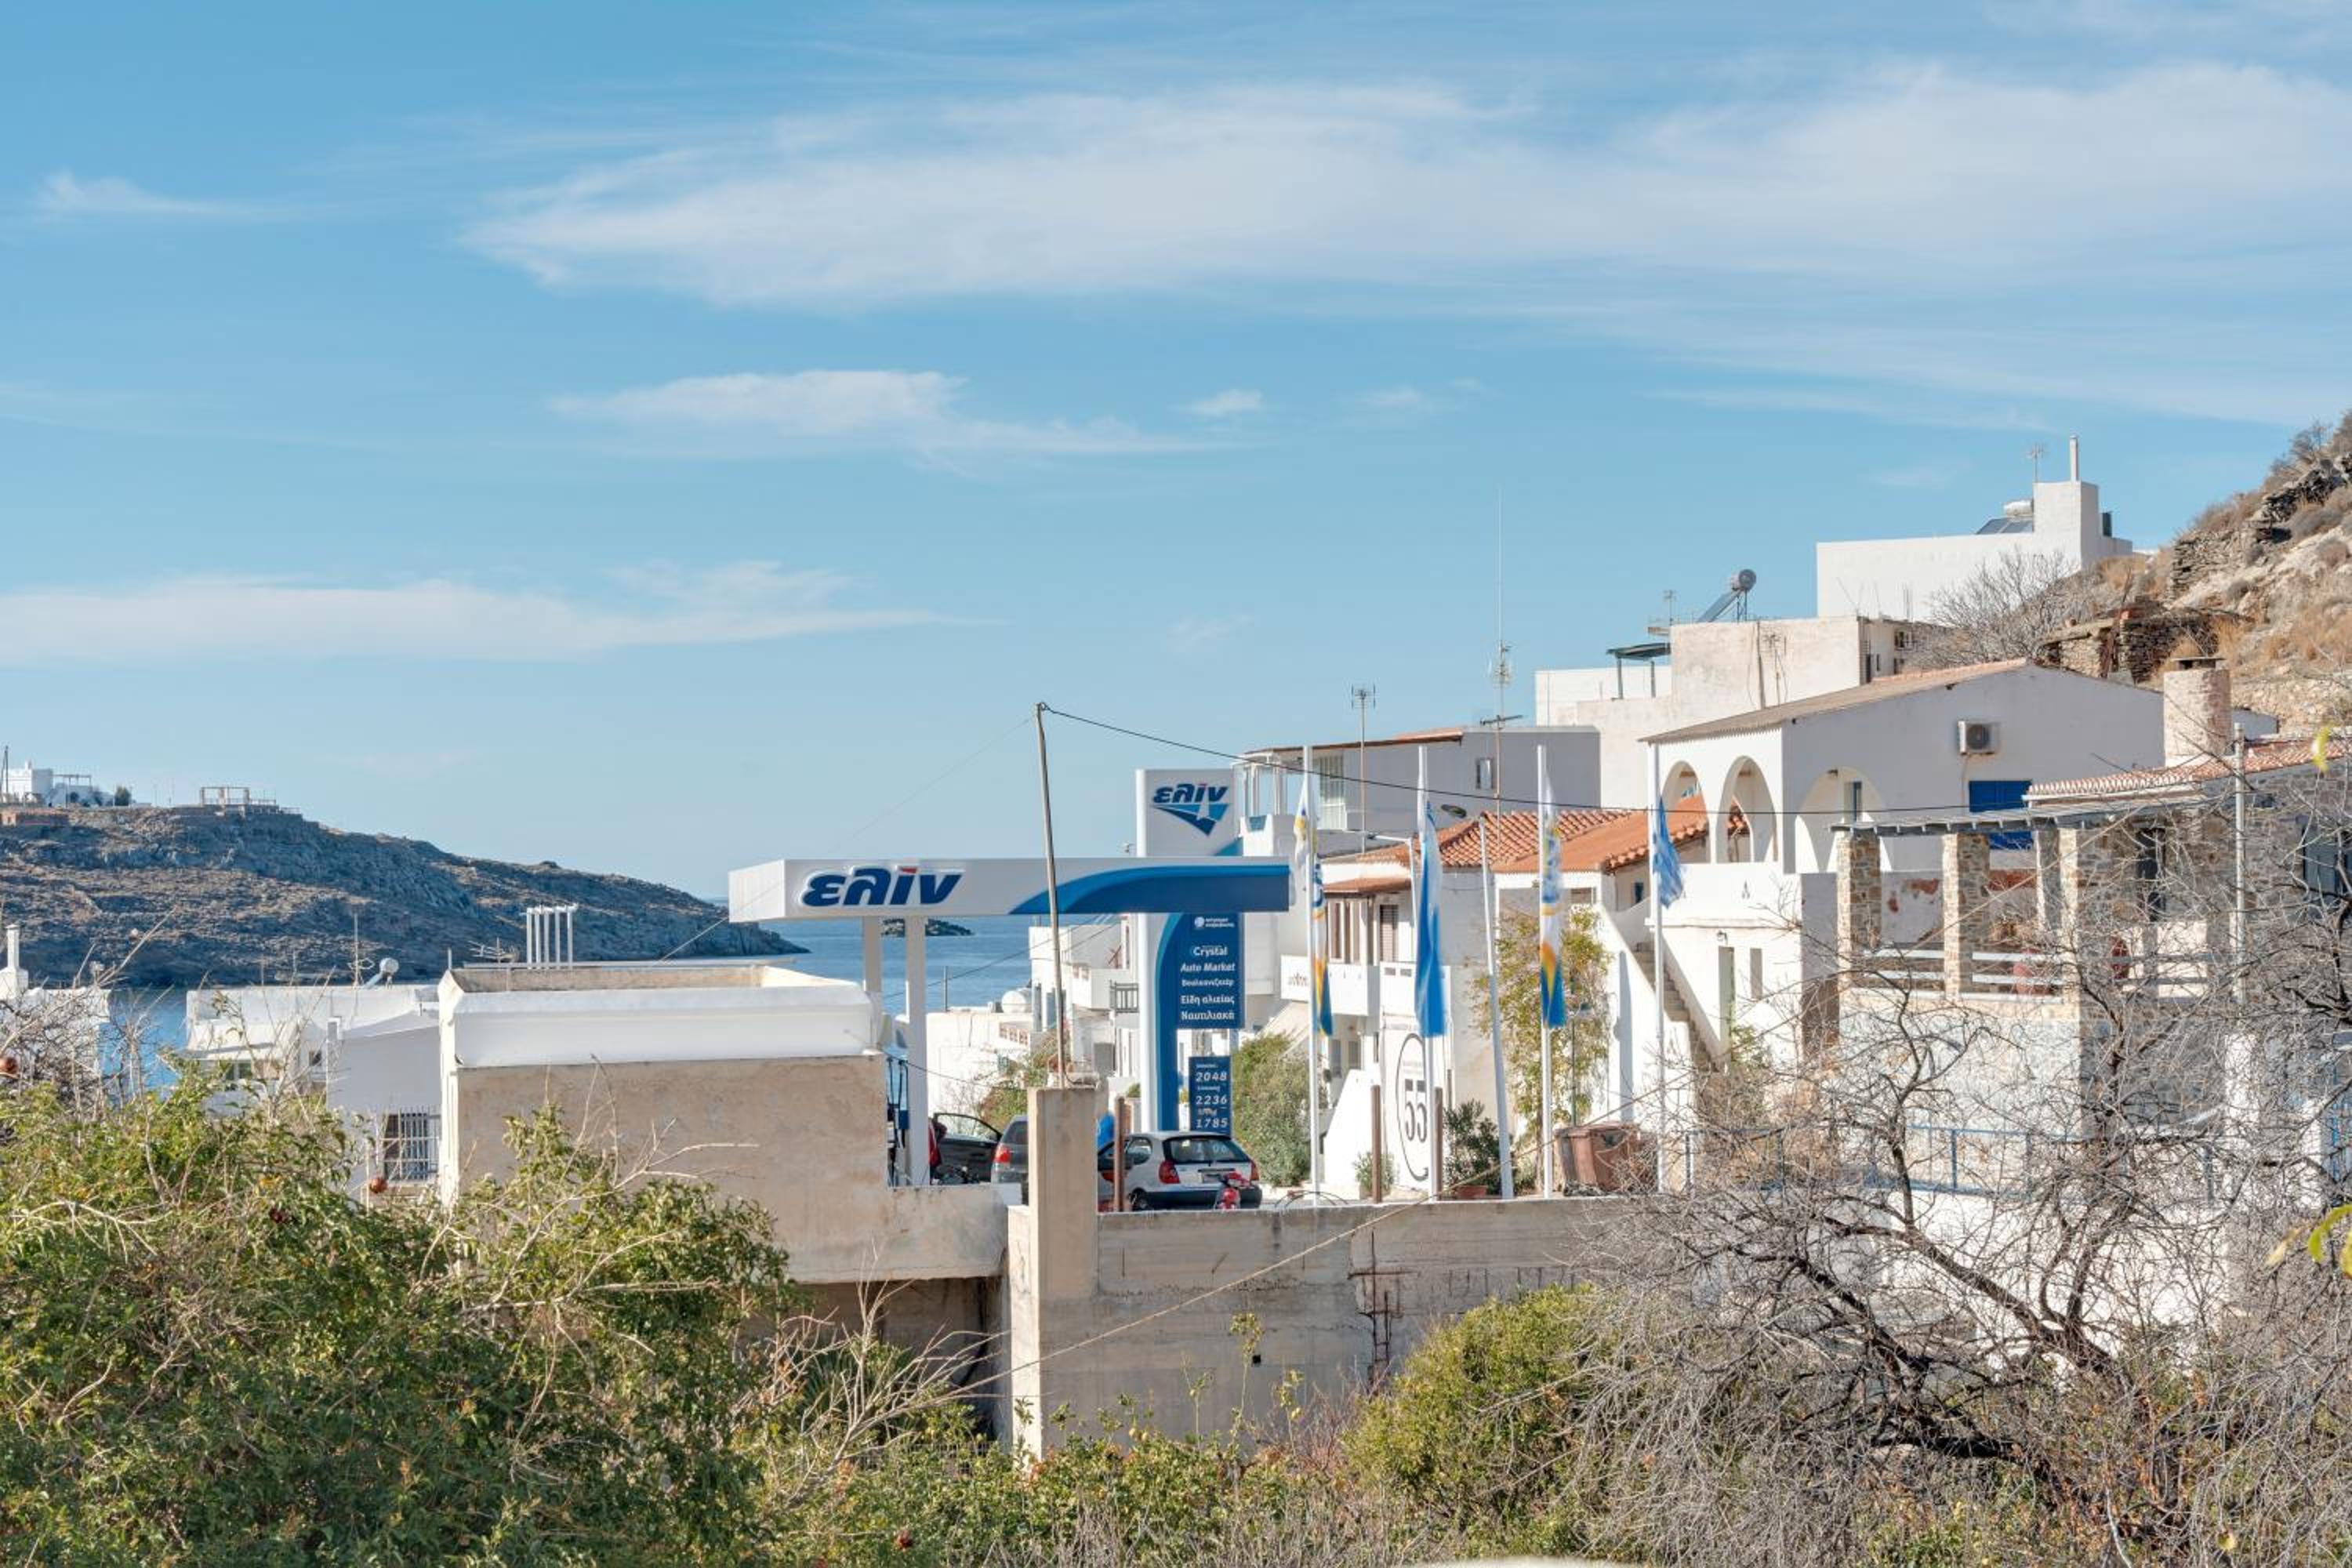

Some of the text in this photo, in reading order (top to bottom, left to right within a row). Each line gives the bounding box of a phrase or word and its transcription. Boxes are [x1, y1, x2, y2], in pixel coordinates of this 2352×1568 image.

[1192, 946, 1228, 957] Crystal
[1181, 963, 1236, 971] Auto Market
[1196, 1072, 1227, 1082] 2048
[1196, 1094, 1227, 1105] 2236
[1196, 1117, 1228, 1128] 1785
